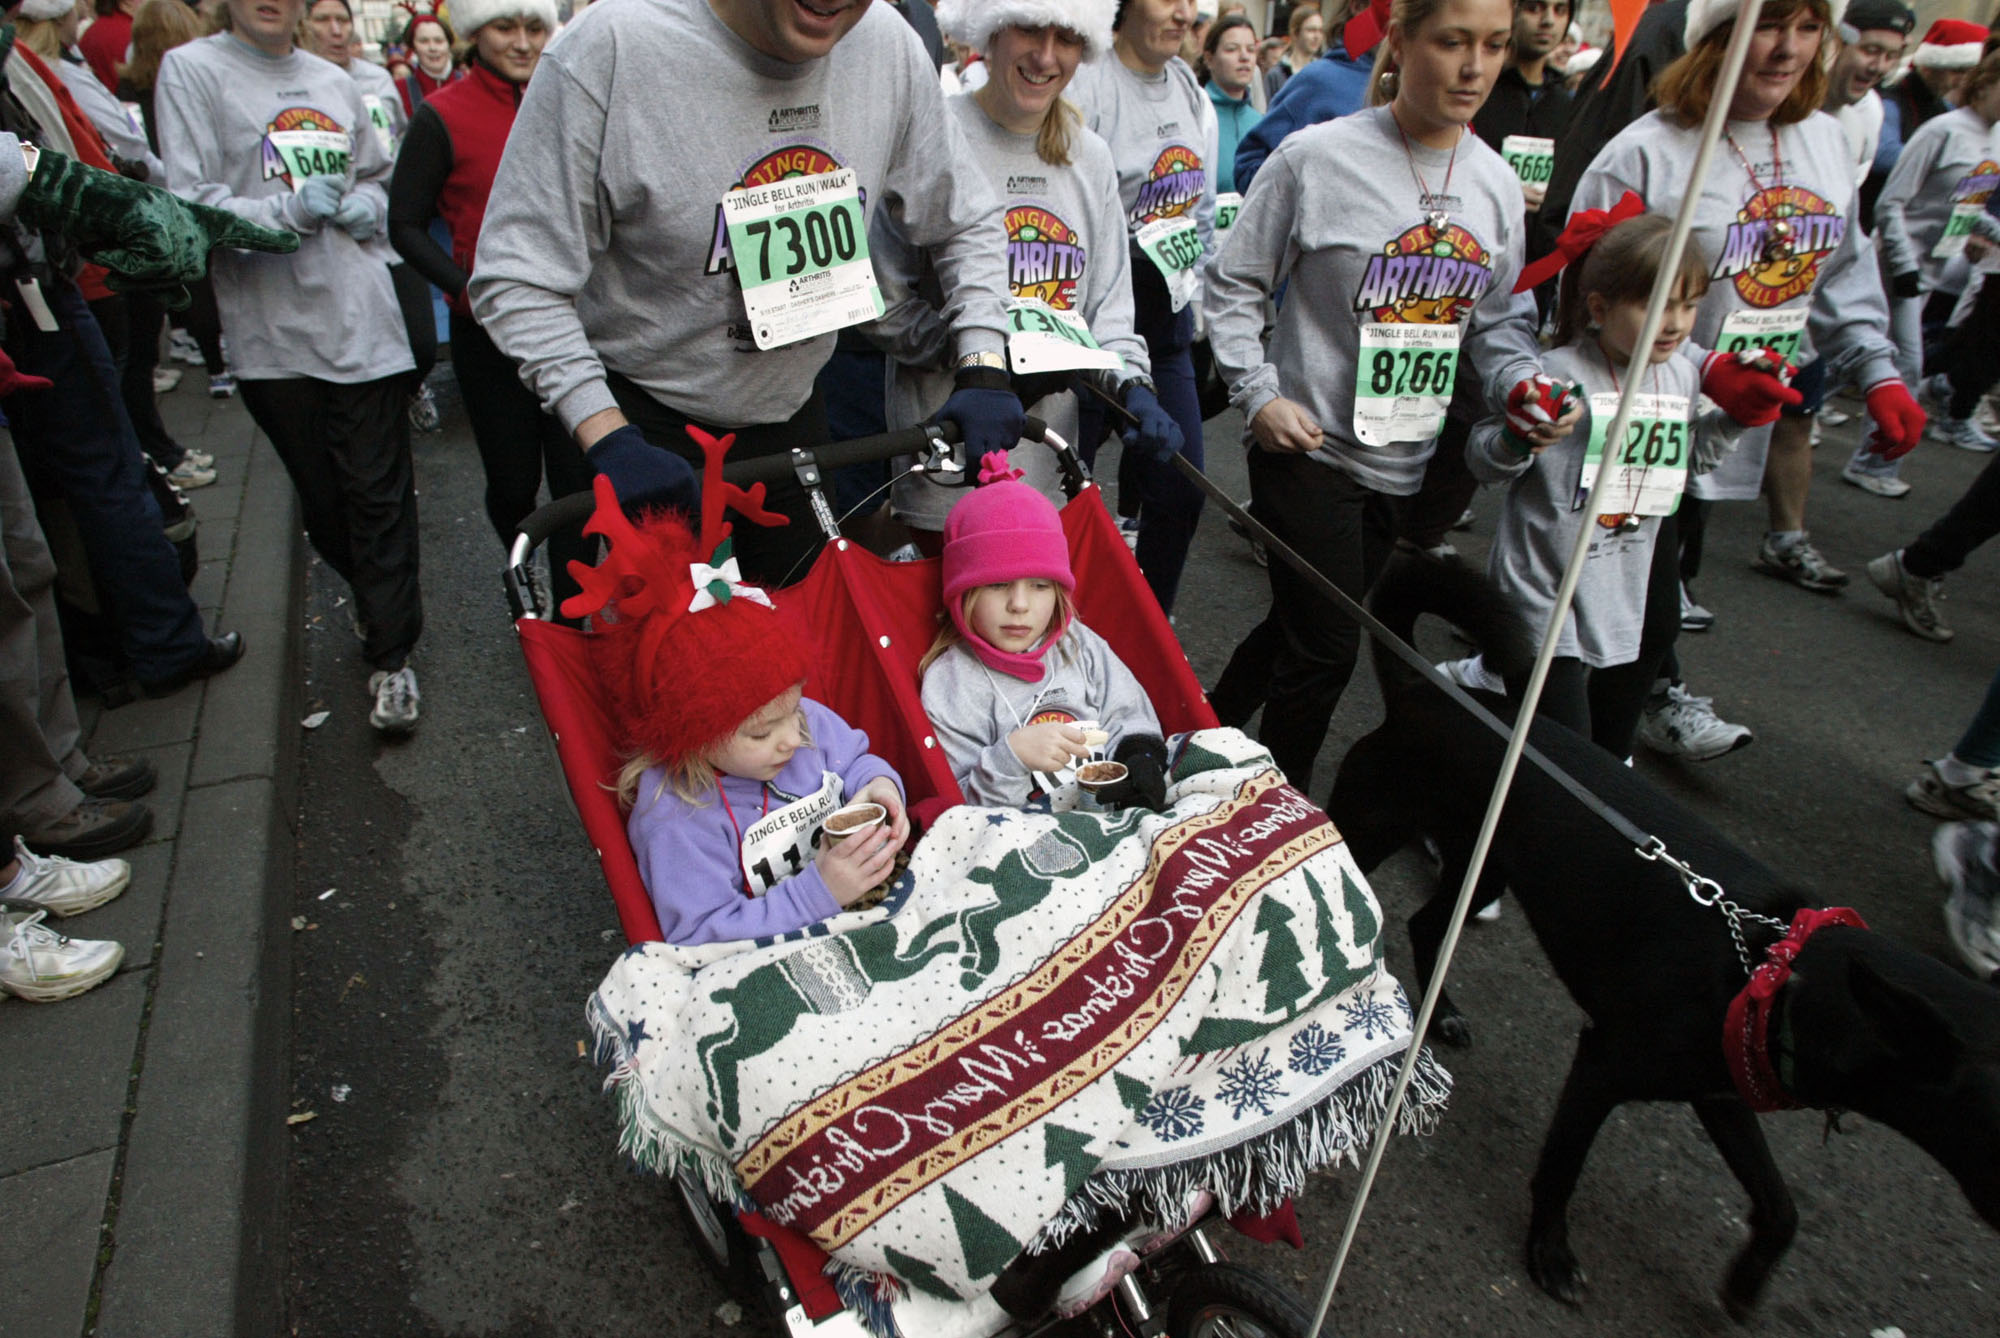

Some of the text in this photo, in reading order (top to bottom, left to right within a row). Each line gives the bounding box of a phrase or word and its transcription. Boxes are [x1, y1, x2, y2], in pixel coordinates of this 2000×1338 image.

[780, 104, 819, 118] ARTHRITIS
[771, 188, 794, 202] BELL
[774, 197, 815, 213] for Arthritis
[1004, 211, 1062, 240] INGLE
[745, 205, 857, 281] 7300
[1408, 228, 1477, 259] JIGLE
[799, 270, 831, 284] ARTHRITIS
[1736, 273, 1772, 306] BELL
[1403, 328, 1420, 338] BELL
[1371, 350, 1453, 396] 8266
[749, 816, 788, 846] JINGLE
[789, 804, 817, 823] BELL
[795, 821, 807, 834] for
